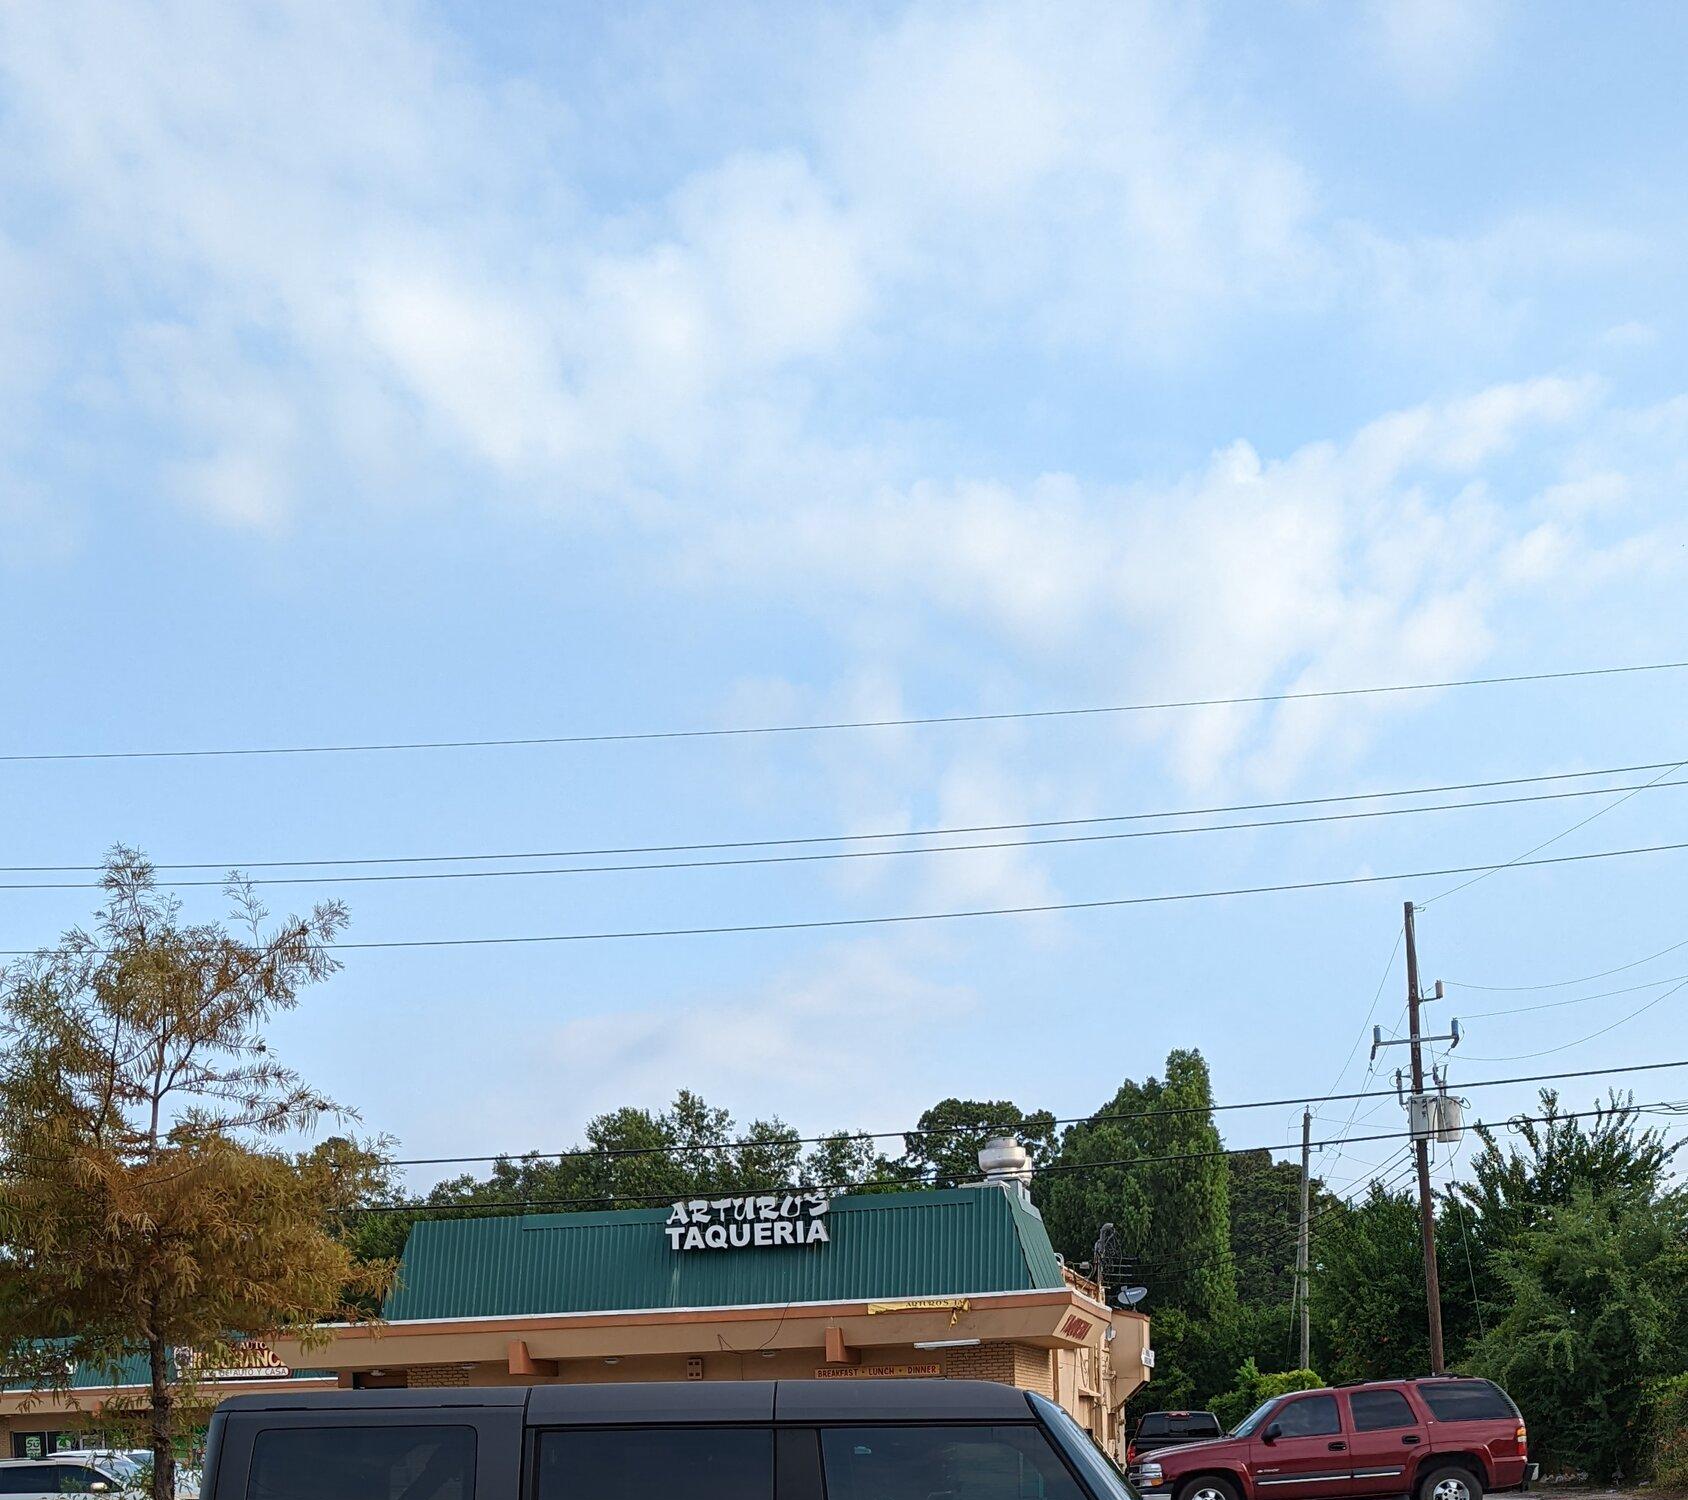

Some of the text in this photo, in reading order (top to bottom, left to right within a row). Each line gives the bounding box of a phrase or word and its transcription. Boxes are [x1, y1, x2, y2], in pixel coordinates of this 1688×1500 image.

[665, 1219, 830, 1250] TAQUERIA
[264, 1367, 287, 1375] CASA
[817, 1365, 936, 1378] BREAKFAST LUNCH DINNER
